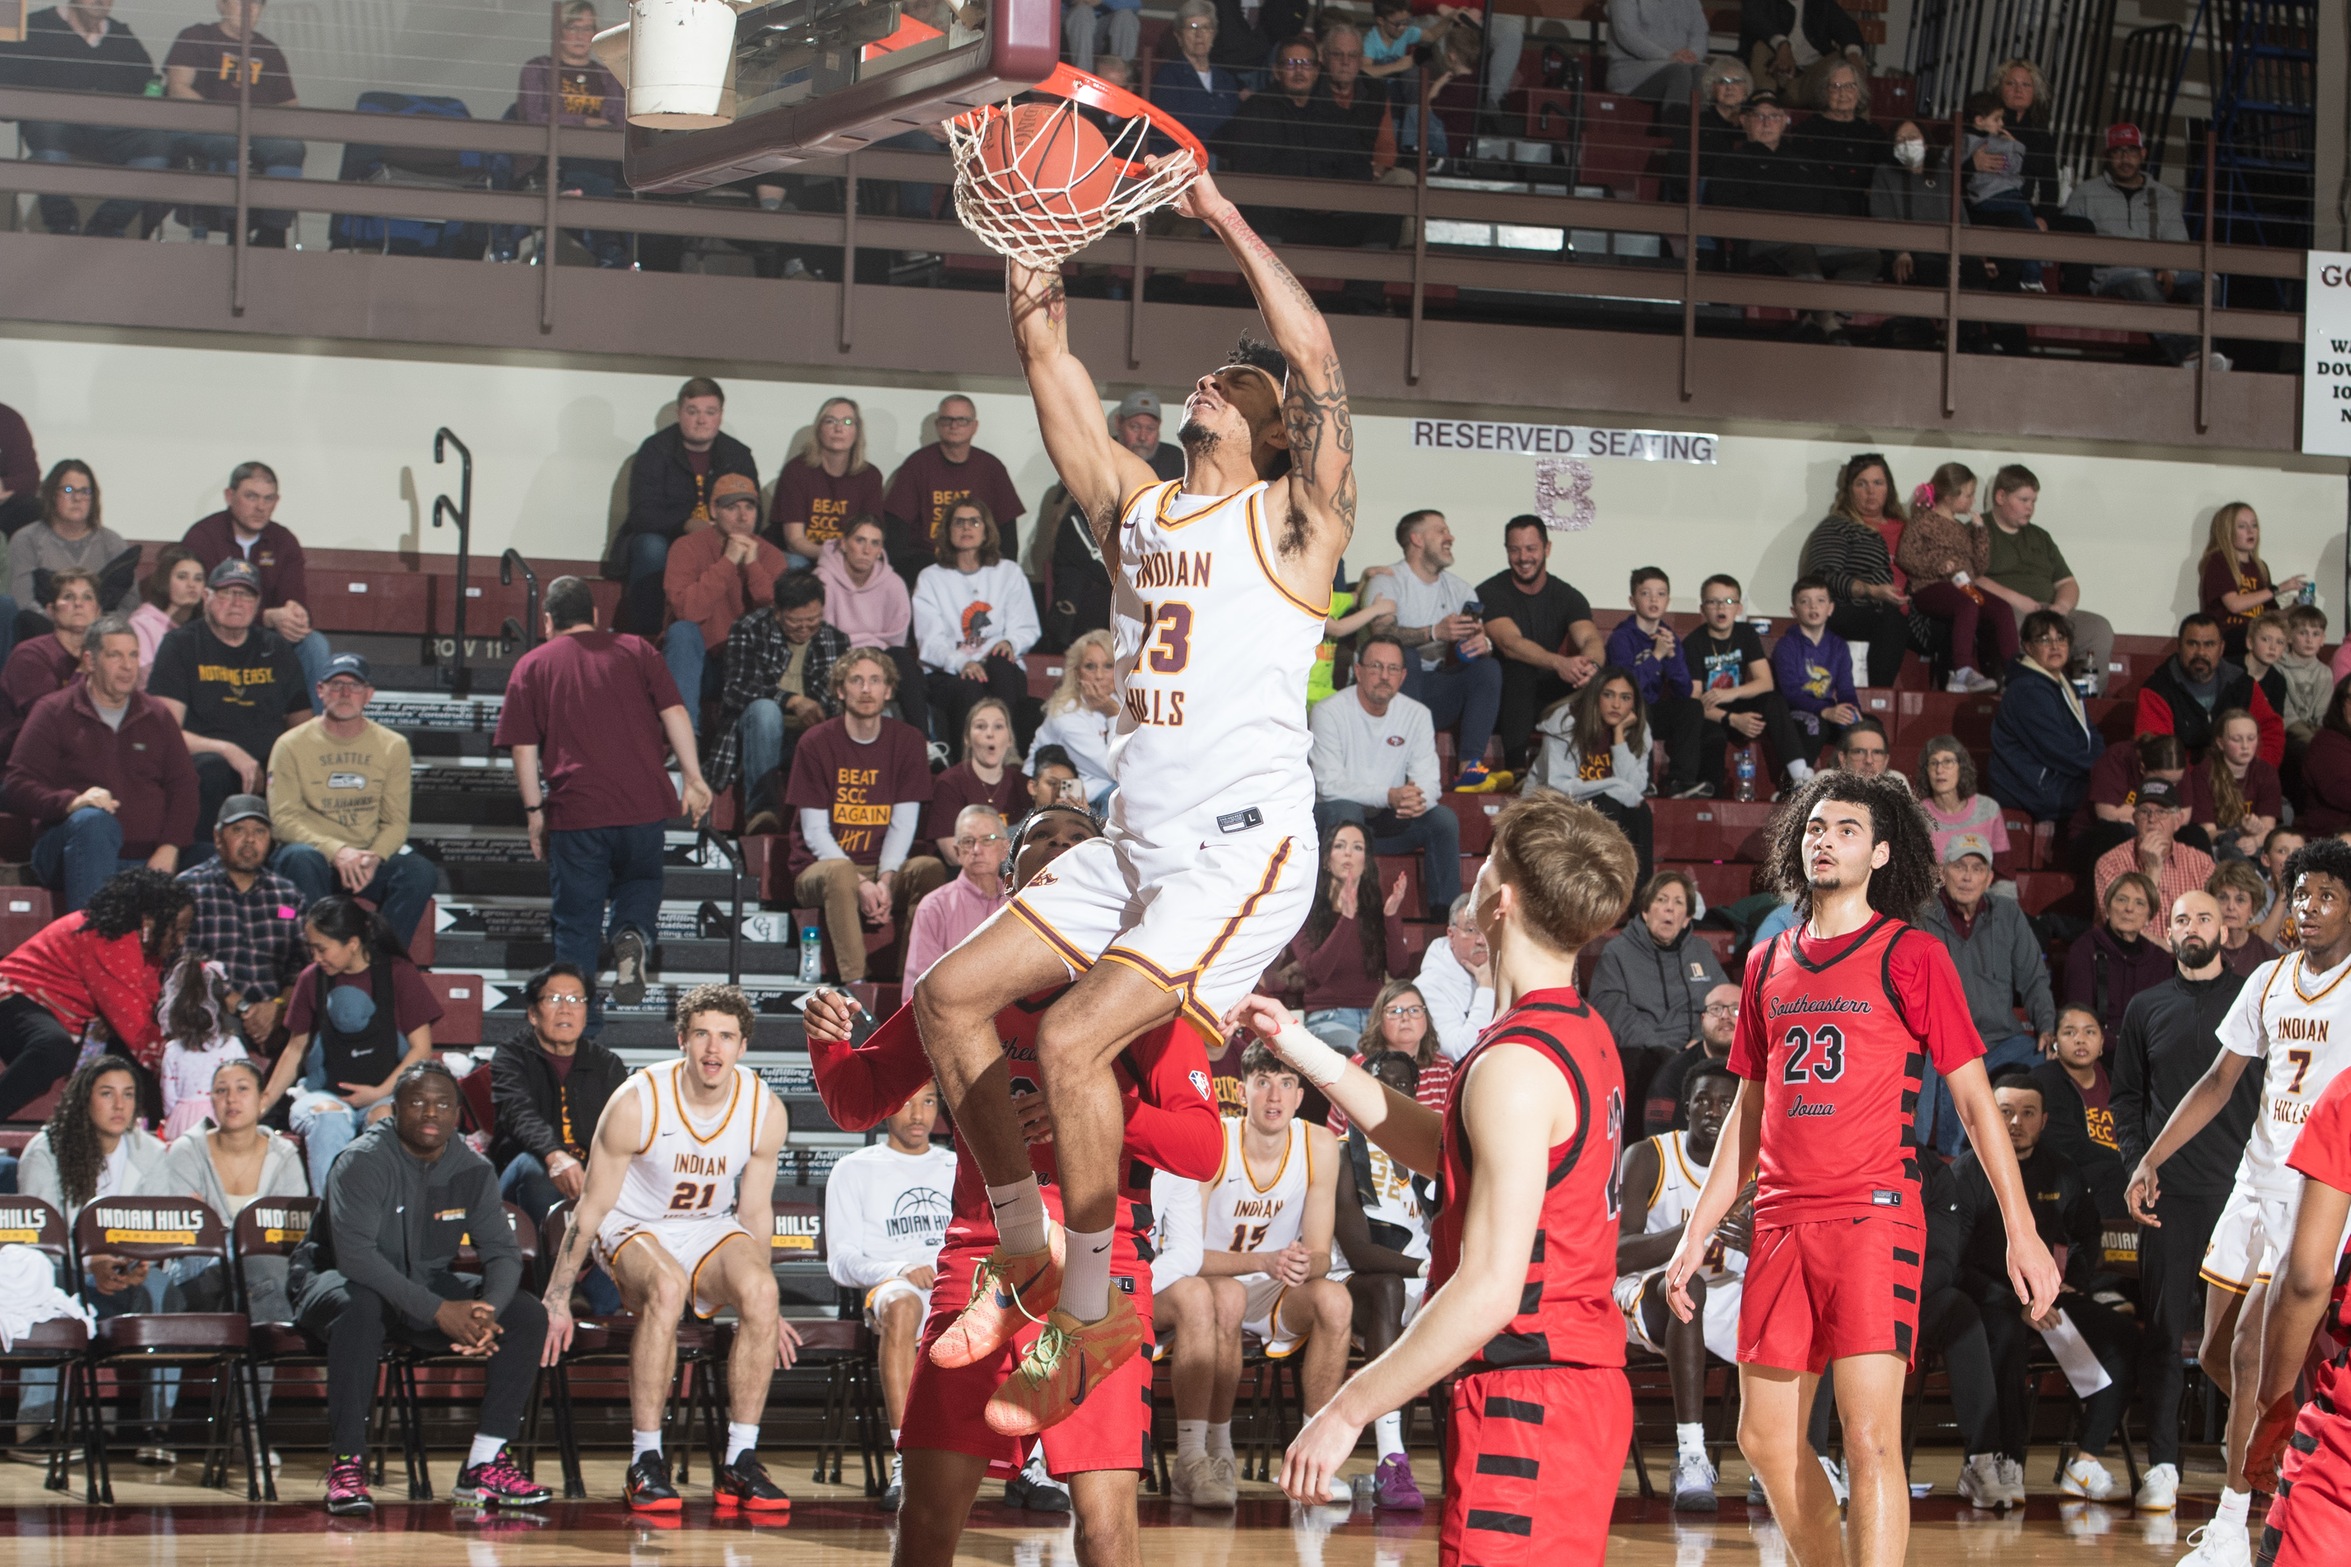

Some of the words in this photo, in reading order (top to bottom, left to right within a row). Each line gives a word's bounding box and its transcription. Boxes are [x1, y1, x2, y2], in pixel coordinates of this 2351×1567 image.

[2320, 264, 2351, 288] G
[2330, 339, 2351, 354] W
[2317, 361, 2351, 375] DO
[1415, 421, 1573, 453] RESERVED
[1589, 431, 1712, 461] SEATING
[1535, 457, 1596, 532] B
[812, 499, 848, 515] BEAT
[810, 515, 839, 531] SCC
[1135, 551, 1212, 588] INDIAN
[1131, 600, 1195, 675] 13
[1126, 688, 1185, 726] HILLS
[319, 752, 372, 766] SEATTLE
[1586, 752, 1611, 767] AT
[838, 768, 878, 785] BEAT
[1579, 765, 1604, 780] SCC
[837, 787, 867, 803] SCC
[835, 806, 889, 823] AGAIN
[1248, 813, 1256, 822] L
[1768, 993, 1872, 1020] Southeastern
[2278, 1017, 2329, 1042] INDIAN
[1783, 1024, 1846, 1085] 23
[2287, 1049, 2312, 1095] 7
[1787, 1094, 1836, 1118] Iowa
[2273, 1099, 2310, 1124] HILLS
[2088, 1122, 2113, 1141] SCC
[673, 1153, 727, 1176] INDIAN
[669, 1181, 717, 1210] 21
[1893, 1195, 1899, 1203] L
[96, 1207, 153, 1230] INDIAN
[156, 1209, 203, 1231] HILLS
[255, 1208, 311, 1228] INDIAN
[1233, 1199, 1284, 1219] INDIAN
[112, 1231, 189, 1241] WARRIORS
[775, 1216, 820, 1236] HILLS
[886, 1215, 931, 1237] INDIAN
[1229, 1223, 1271, 1252] 15
[1703, 1238, 1725, 1275] 4
[1125, 1281, 1130, 1289] L
